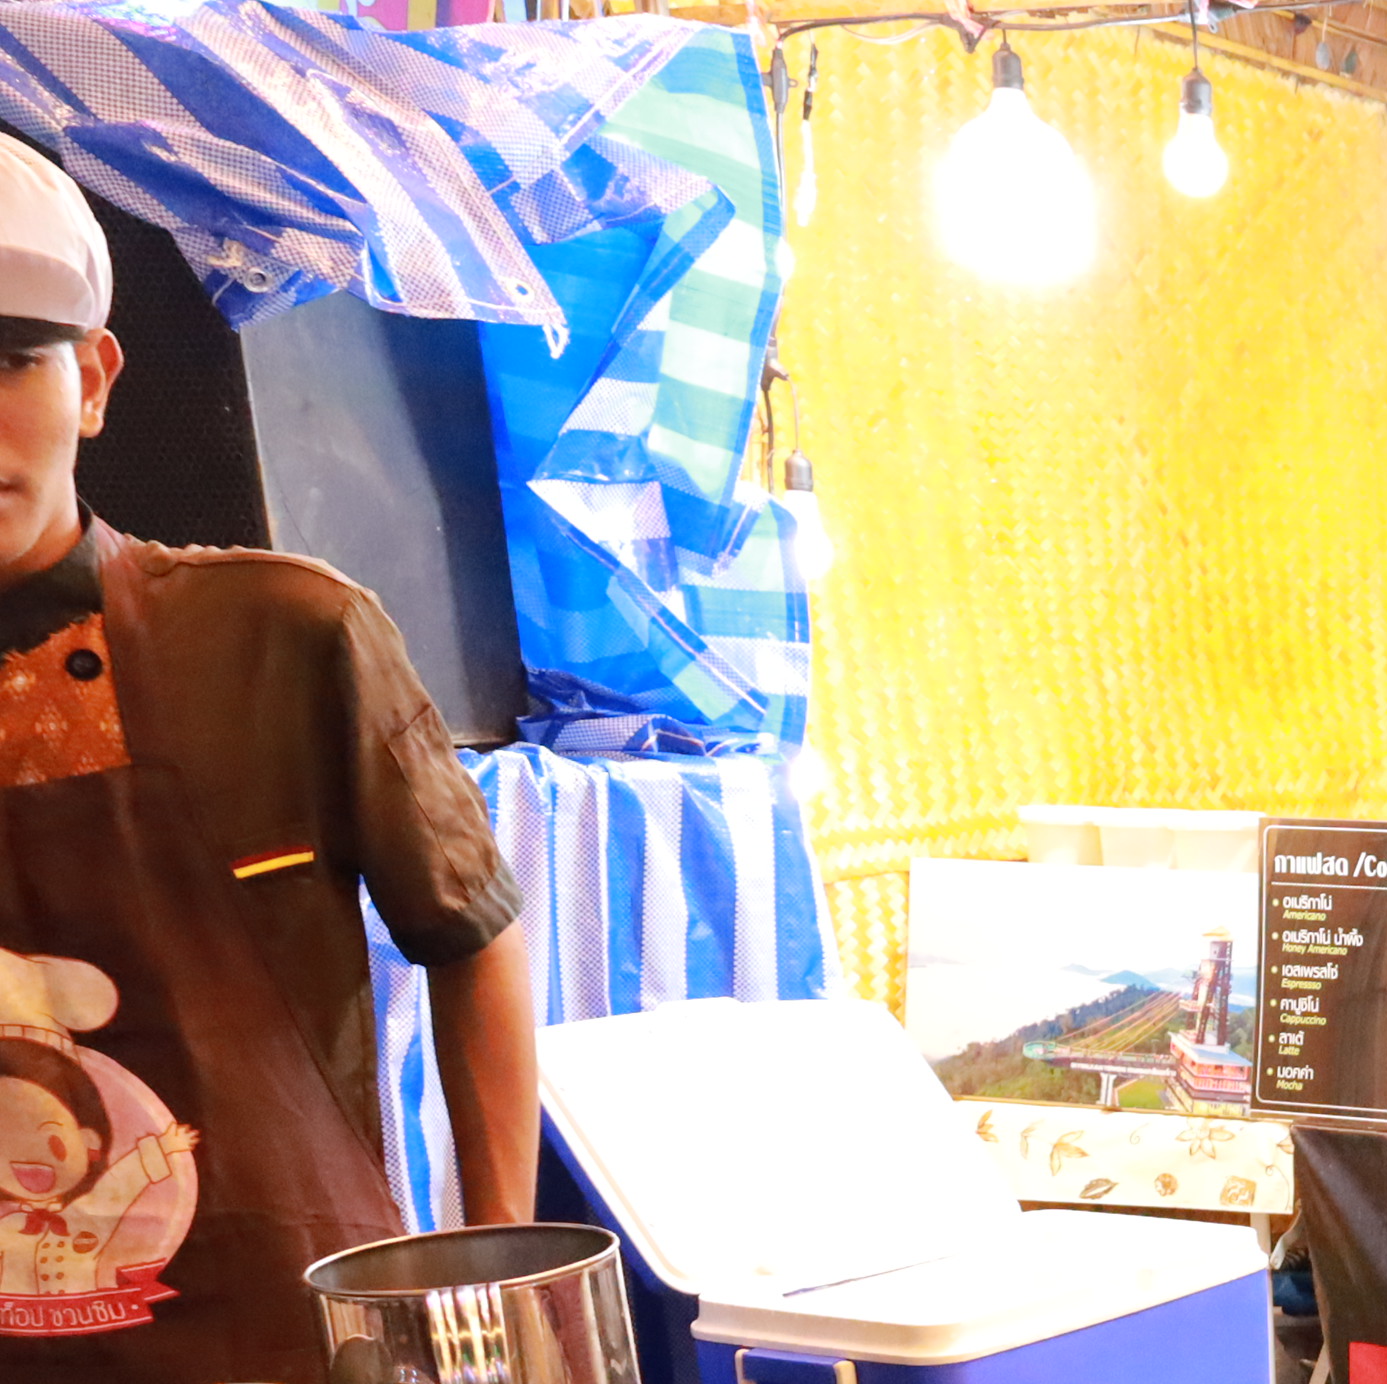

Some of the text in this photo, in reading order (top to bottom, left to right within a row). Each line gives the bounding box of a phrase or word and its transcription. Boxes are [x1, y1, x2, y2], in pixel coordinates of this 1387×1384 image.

[1273, 852, 1349, 876] กาแฟสด
[1282, 909, 1327, 922] Americano
[1281, 943, 1349, 956] Honey Americano
[1279, 1012, 1328, 1026] Cappuccino
[1278, 1044, 1301, 1056] Latte
[1276, 1079, 1304, 1091] Mocha
